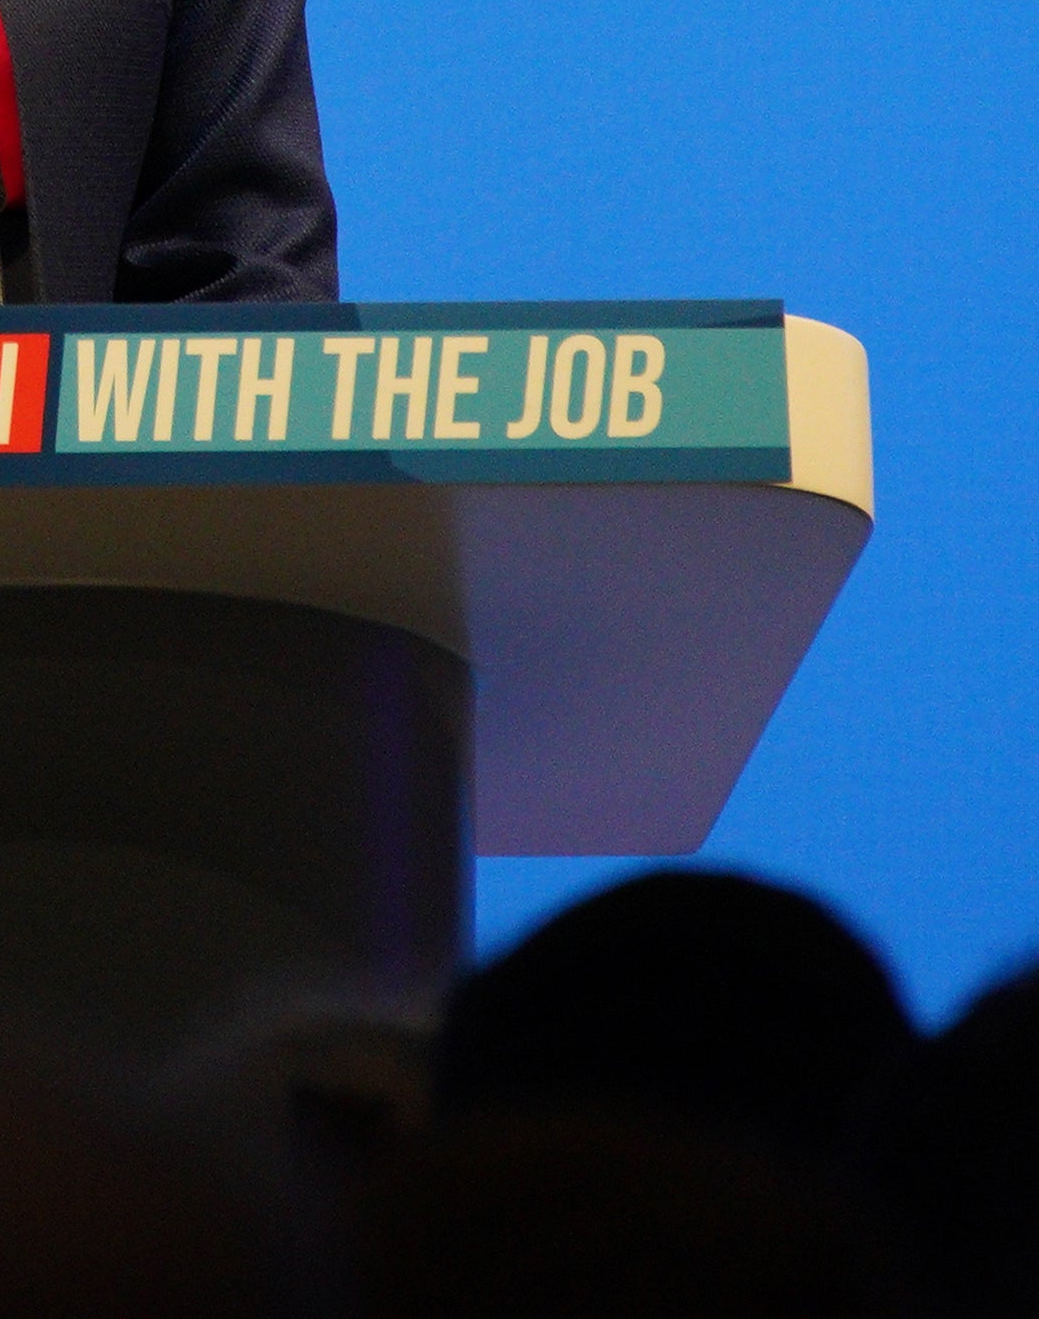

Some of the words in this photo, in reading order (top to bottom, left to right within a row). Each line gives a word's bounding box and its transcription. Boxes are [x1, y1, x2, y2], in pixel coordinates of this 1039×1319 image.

[75, 336, 297, 443] WITH
[321, 335, 490, 442] THE
[505, 332, 667, 441] JOB
